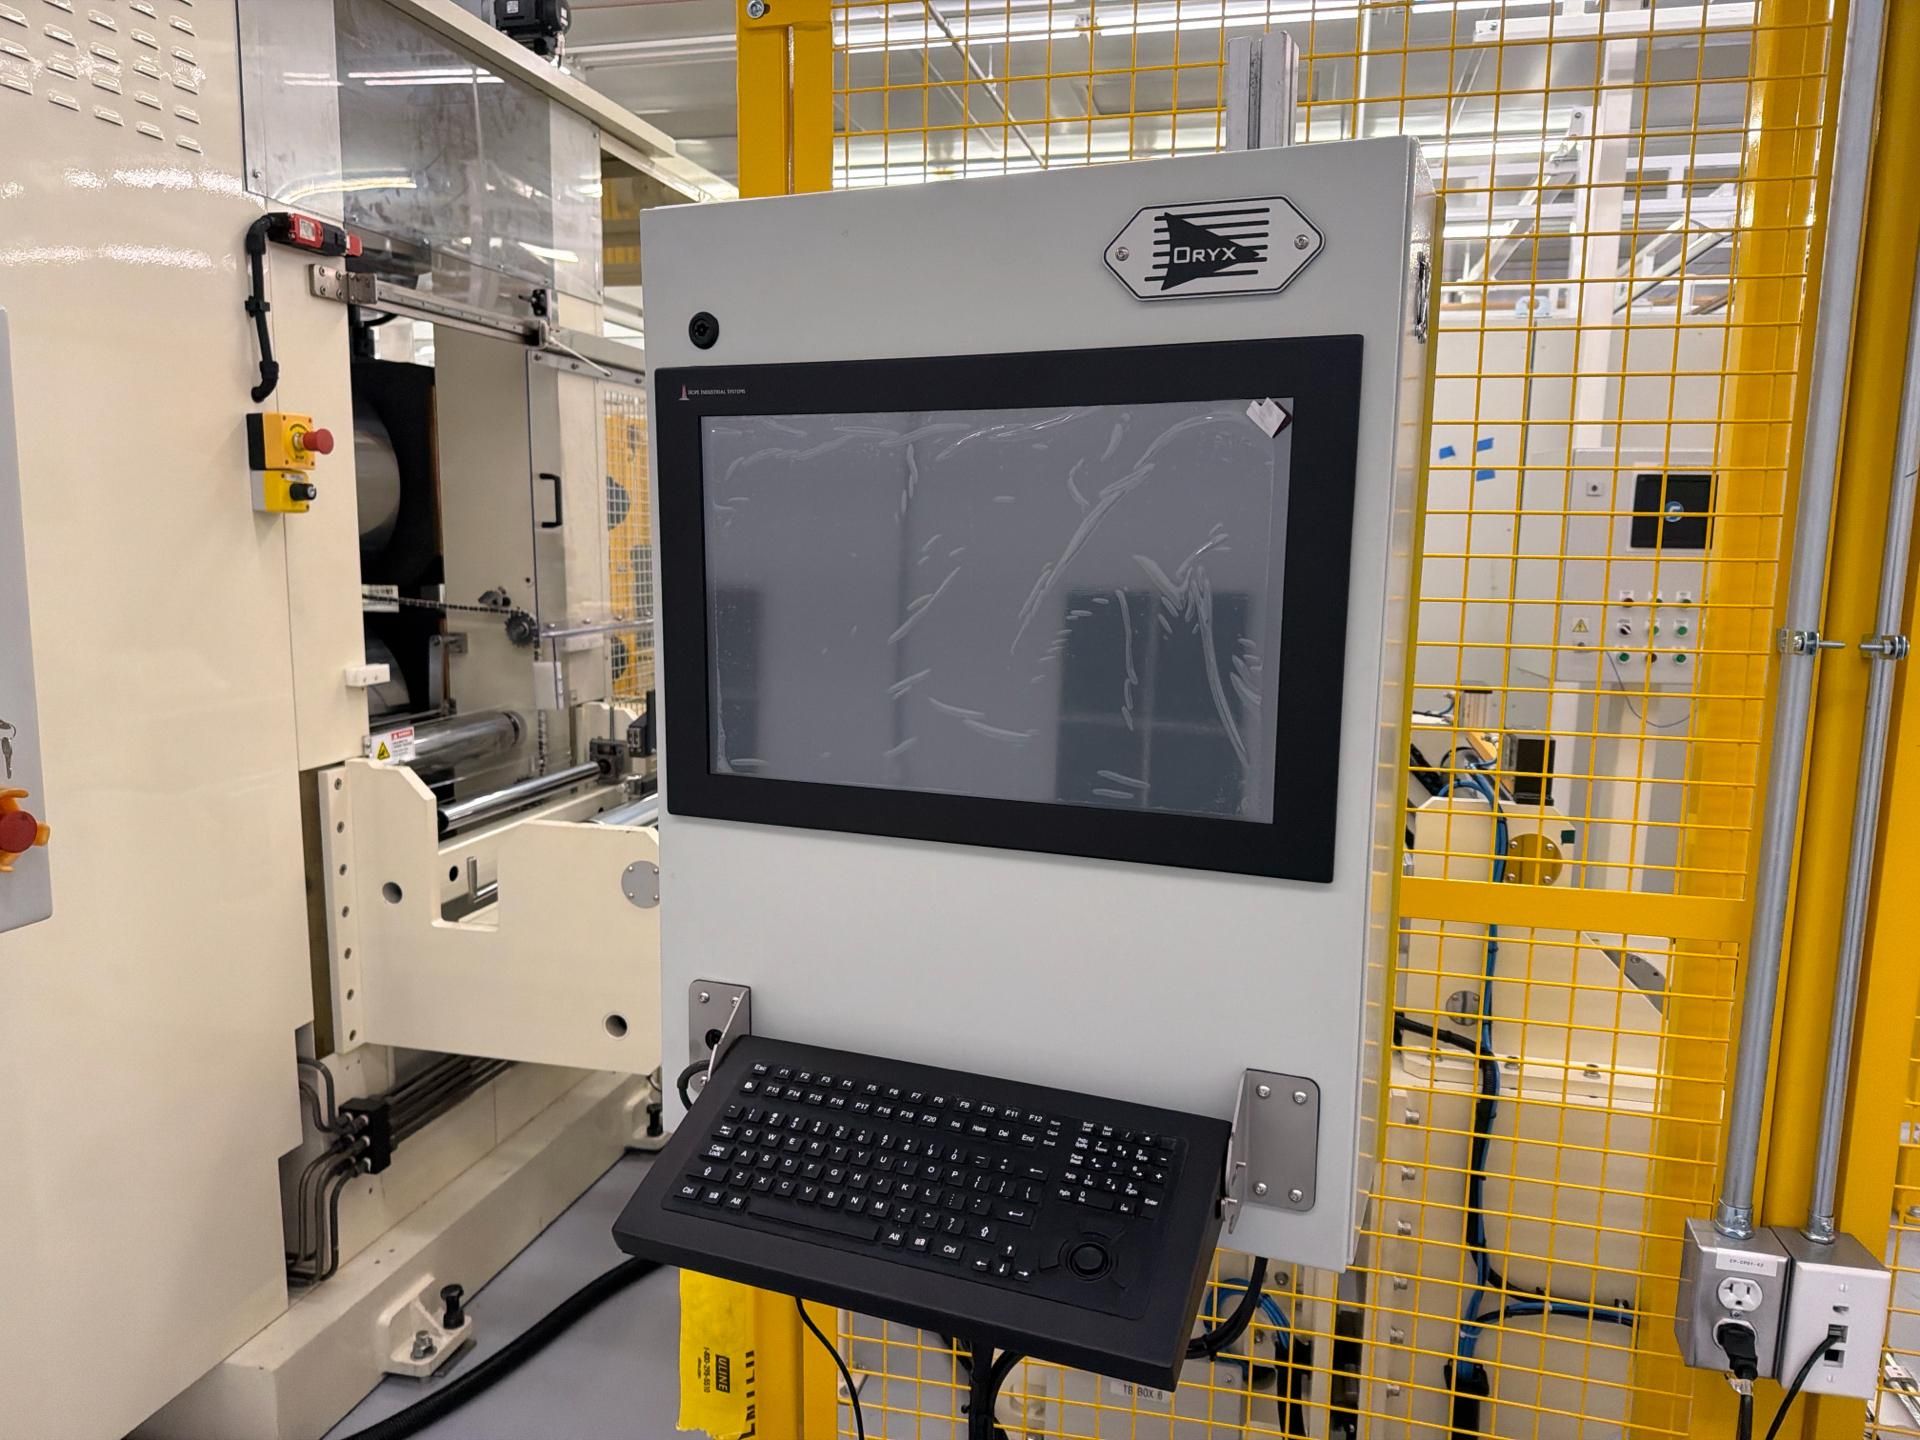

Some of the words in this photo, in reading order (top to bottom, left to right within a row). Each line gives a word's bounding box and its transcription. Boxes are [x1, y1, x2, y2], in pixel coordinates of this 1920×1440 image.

[1173, 246, 1237, 264] ORYX
[766, 1086, 779, 1094] F13
[808, 1093, 822, 1101] F15
[830, 1097, 843, 1105] F16
[922, 1115, 937, 1123] F20
[800, 1072, 810, 1080] F2
[981, 1105, 995, 1113] F10
[1005, 1110, 1018, 1118] F11
[1022, 1134, 1034, 1142] End
[718, 1357, 728, 1391] ULINE
[1136, 1387, 1154, 1399] BOX
